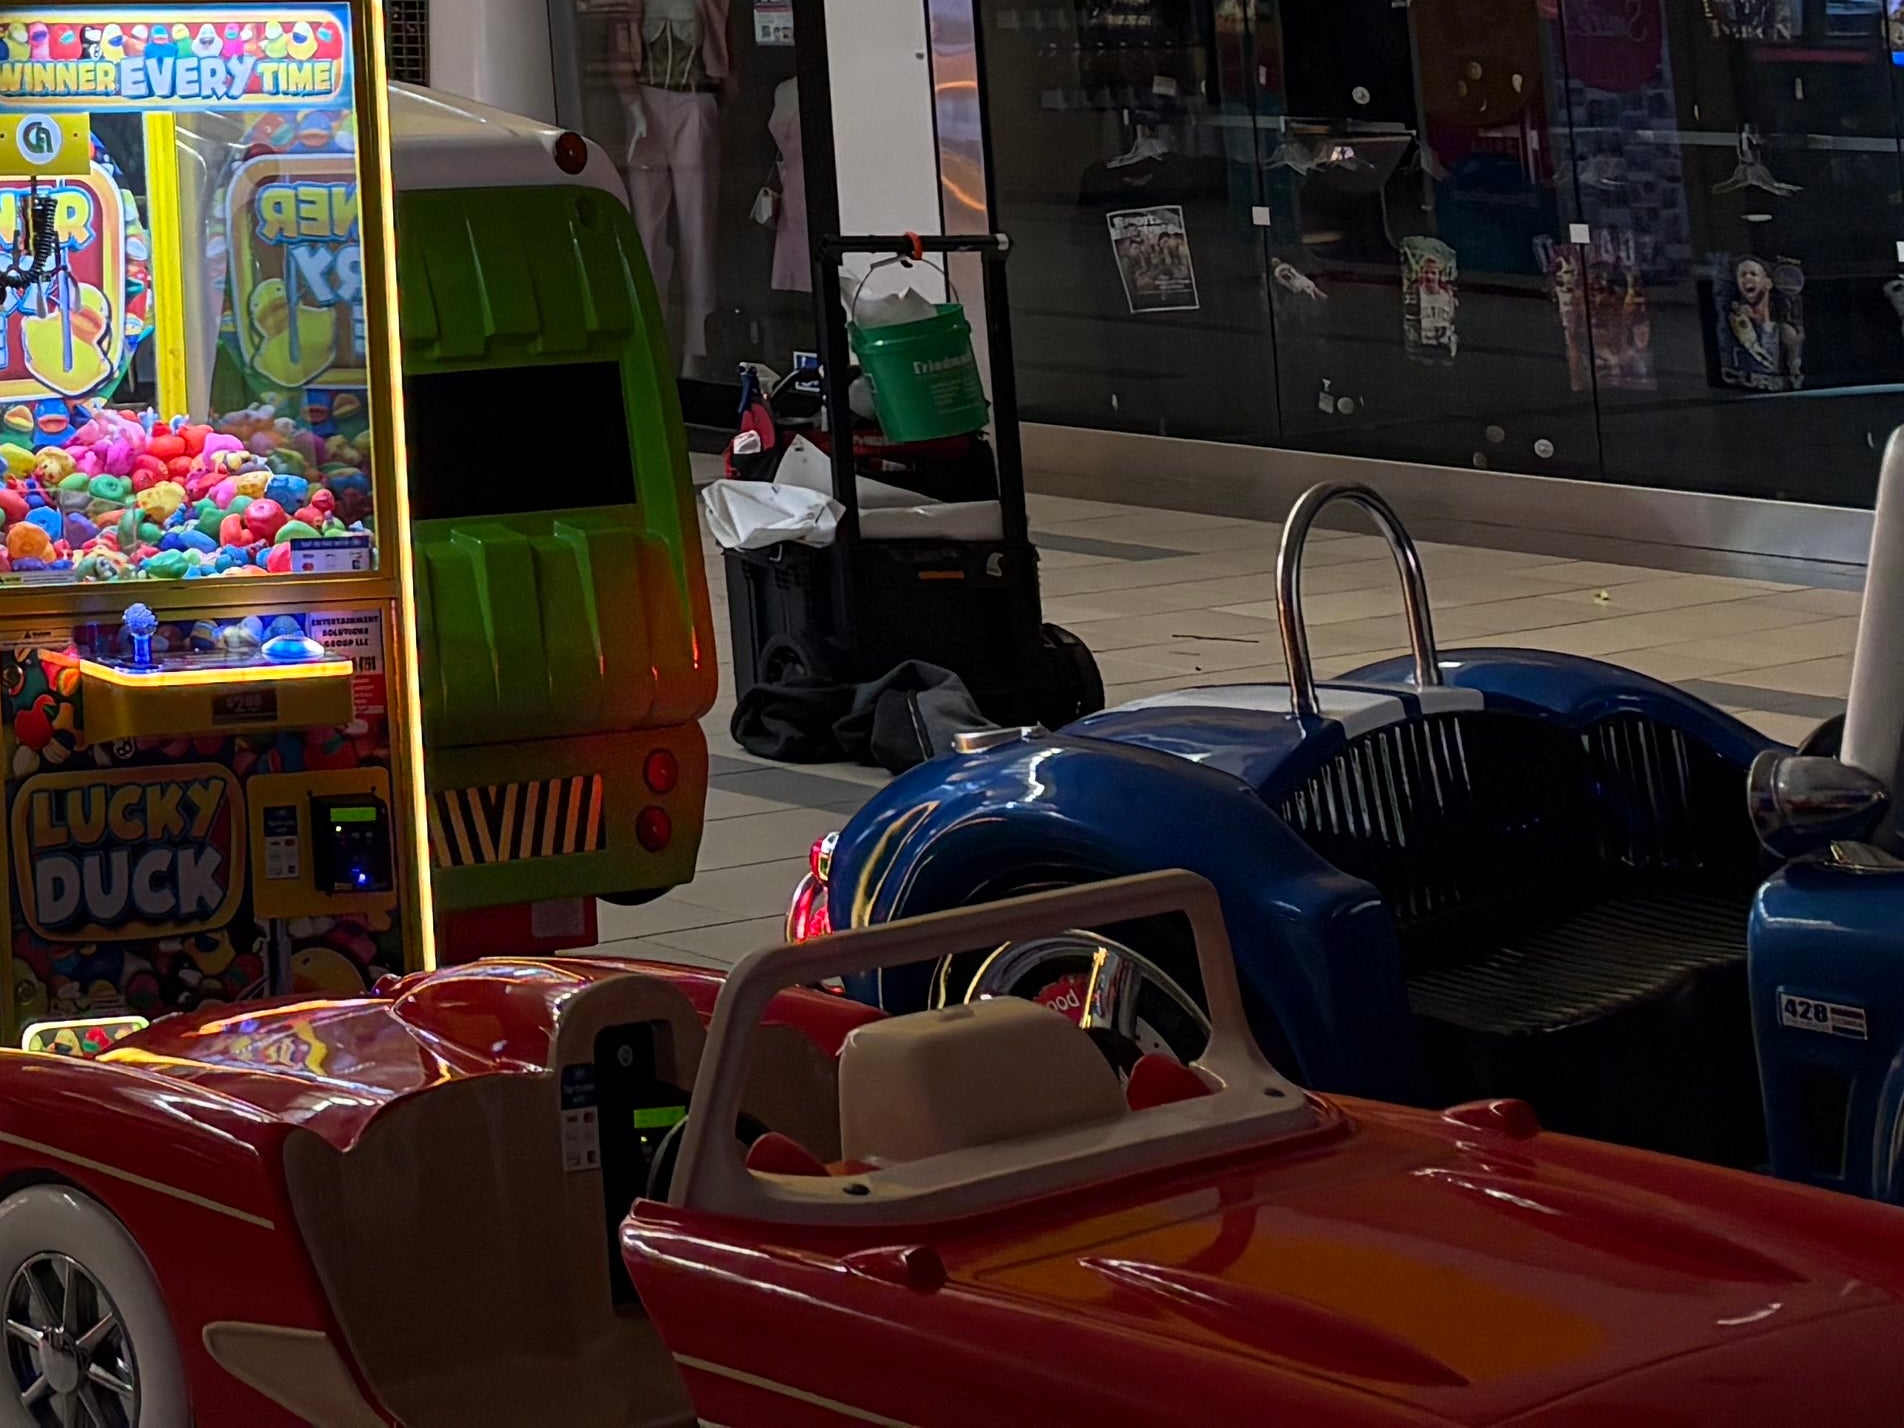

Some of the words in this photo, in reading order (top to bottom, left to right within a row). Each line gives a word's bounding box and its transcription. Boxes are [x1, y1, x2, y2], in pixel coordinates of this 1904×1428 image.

[119, 55, 258, 100] EVERY
[259, 58, 334, 93] TIME
[32, 777, 227, 847] LUCKY
[34, 845, 225, 926] DUCK
